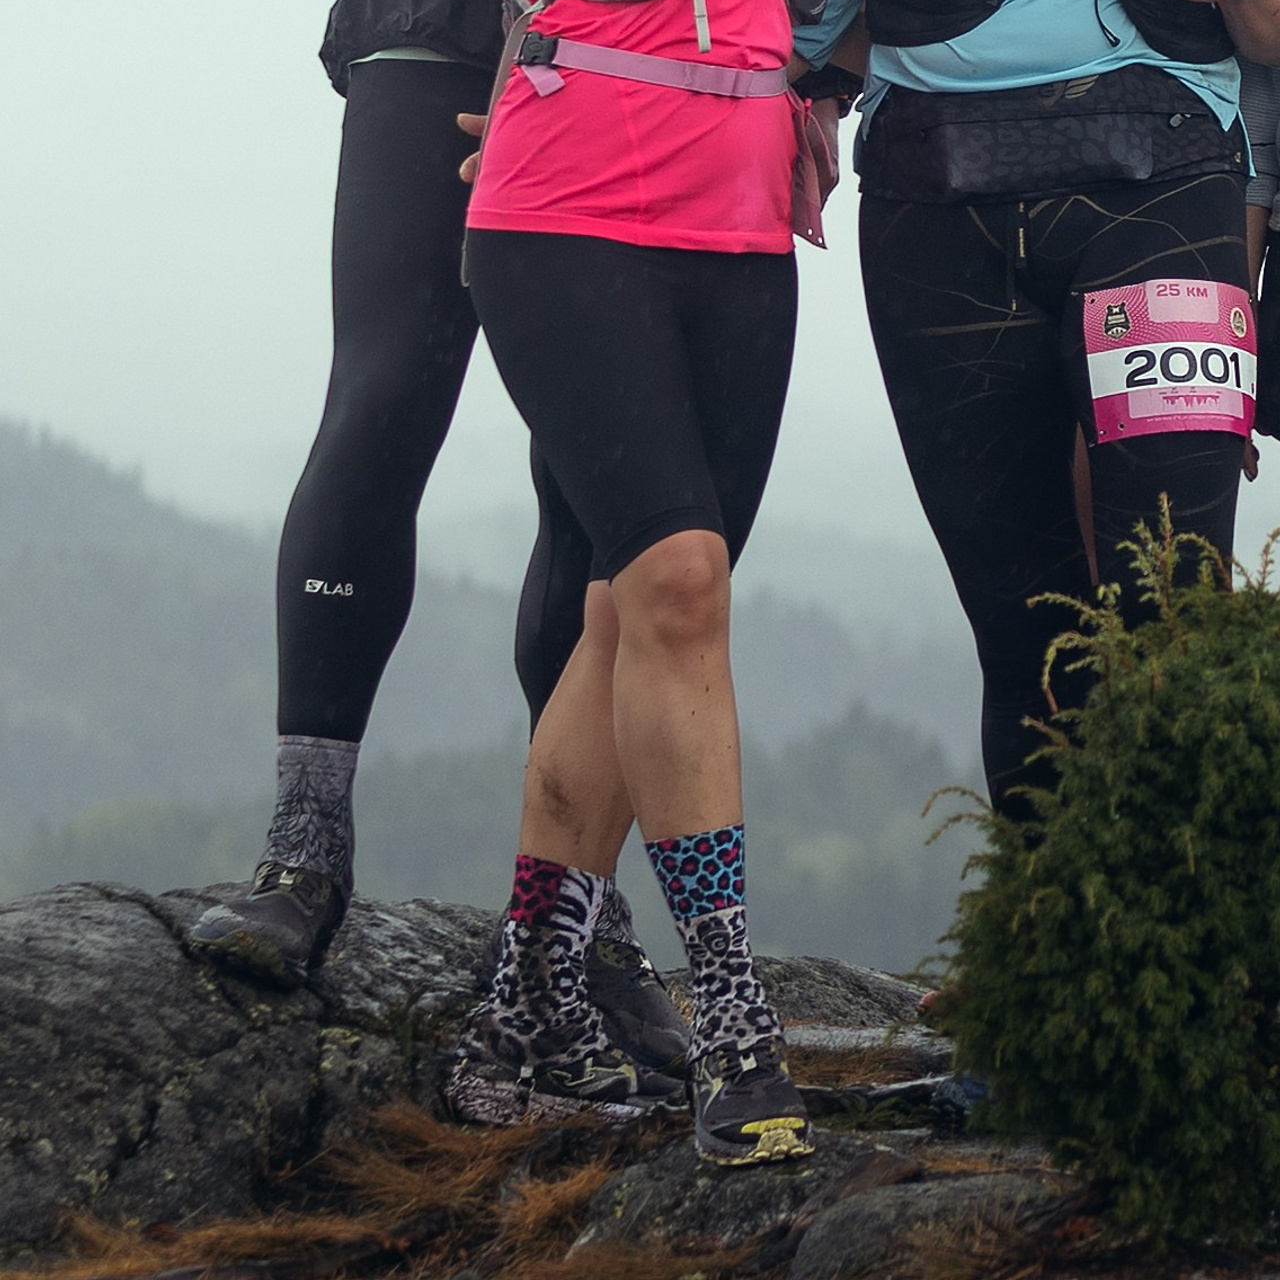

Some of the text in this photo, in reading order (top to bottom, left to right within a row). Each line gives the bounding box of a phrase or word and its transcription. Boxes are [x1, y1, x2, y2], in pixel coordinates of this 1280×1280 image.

[1156, 283, 1208, 298] 25 KM
[1124, 346, 1242, 389] 2001
